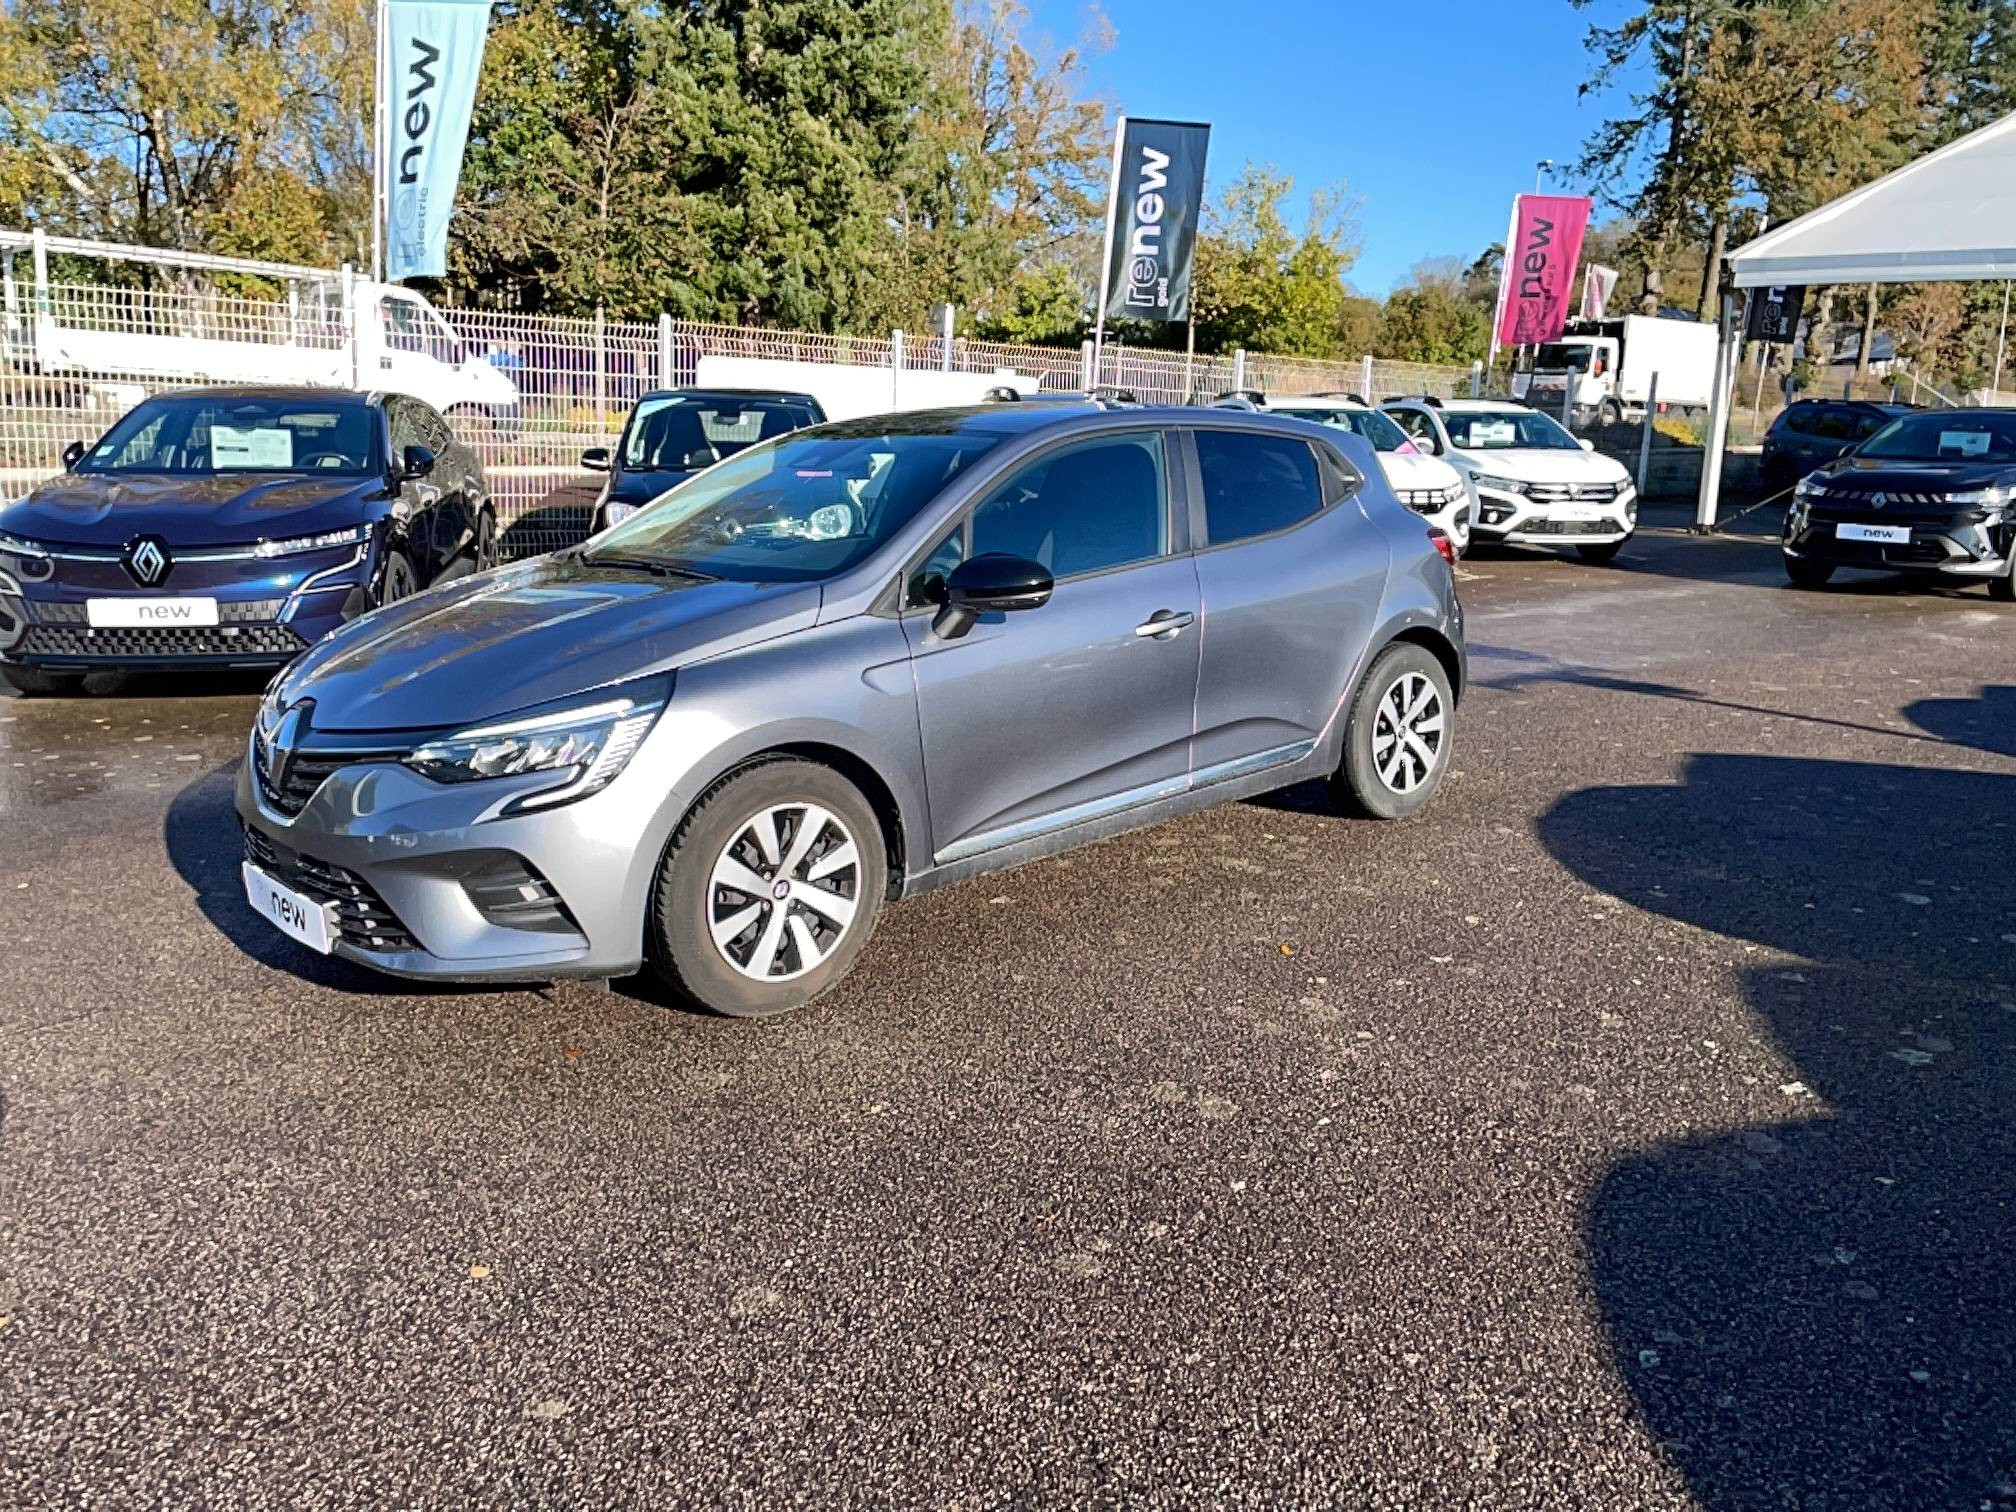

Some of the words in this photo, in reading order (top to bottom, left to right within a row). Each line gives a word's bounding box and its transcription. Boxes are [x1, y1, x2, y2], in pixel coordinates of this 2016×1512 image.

[415, 186, 429, 257] electric
[1125, 146, 1170, 307] renew
[1864, 529, 1894, 538] new
[139, 605, 191, 619] new
[271, 892, 304, 931] new
